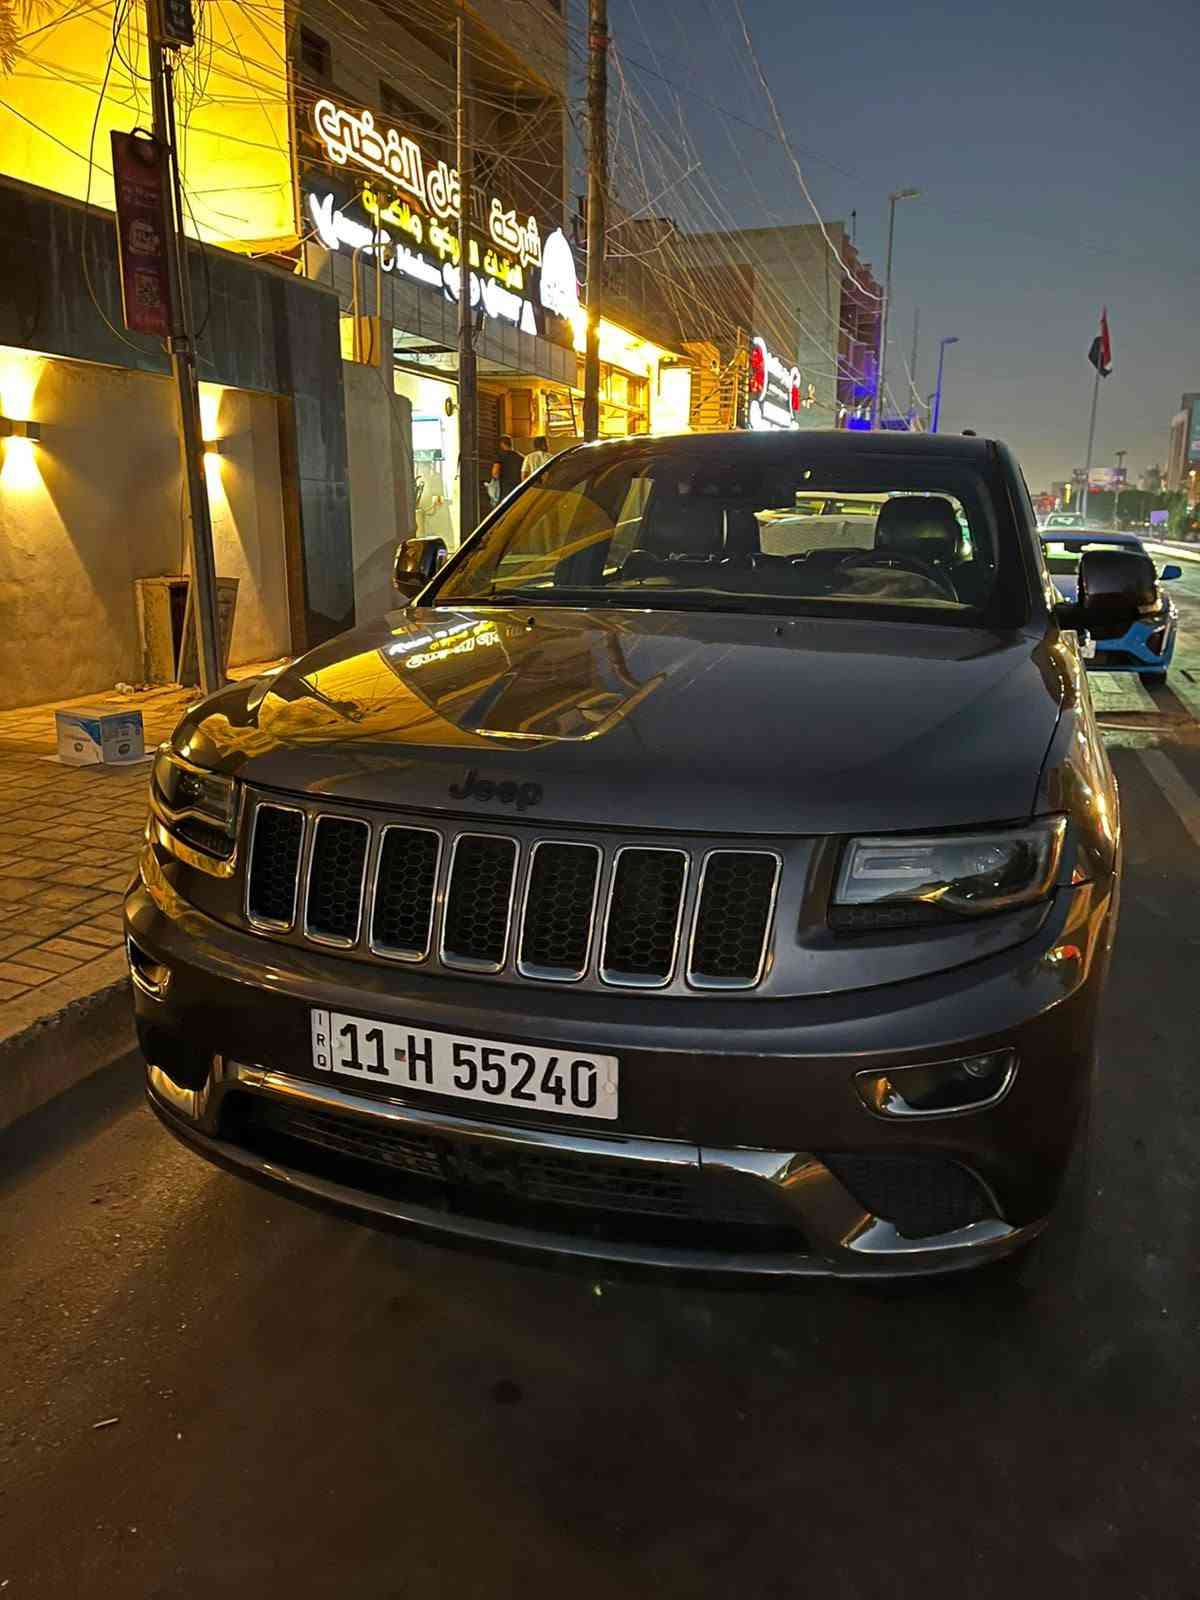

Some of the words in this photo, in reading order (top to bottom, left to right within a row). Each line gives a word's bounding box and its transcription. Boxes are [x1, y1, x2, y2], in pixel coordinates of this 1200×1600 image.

[448, 769, 543, 811] Jeep
[339, 1022, 389, 1076] 11
[407, 1034, 434, 1084] H
[452, 1042, 597, 1109] 55240
